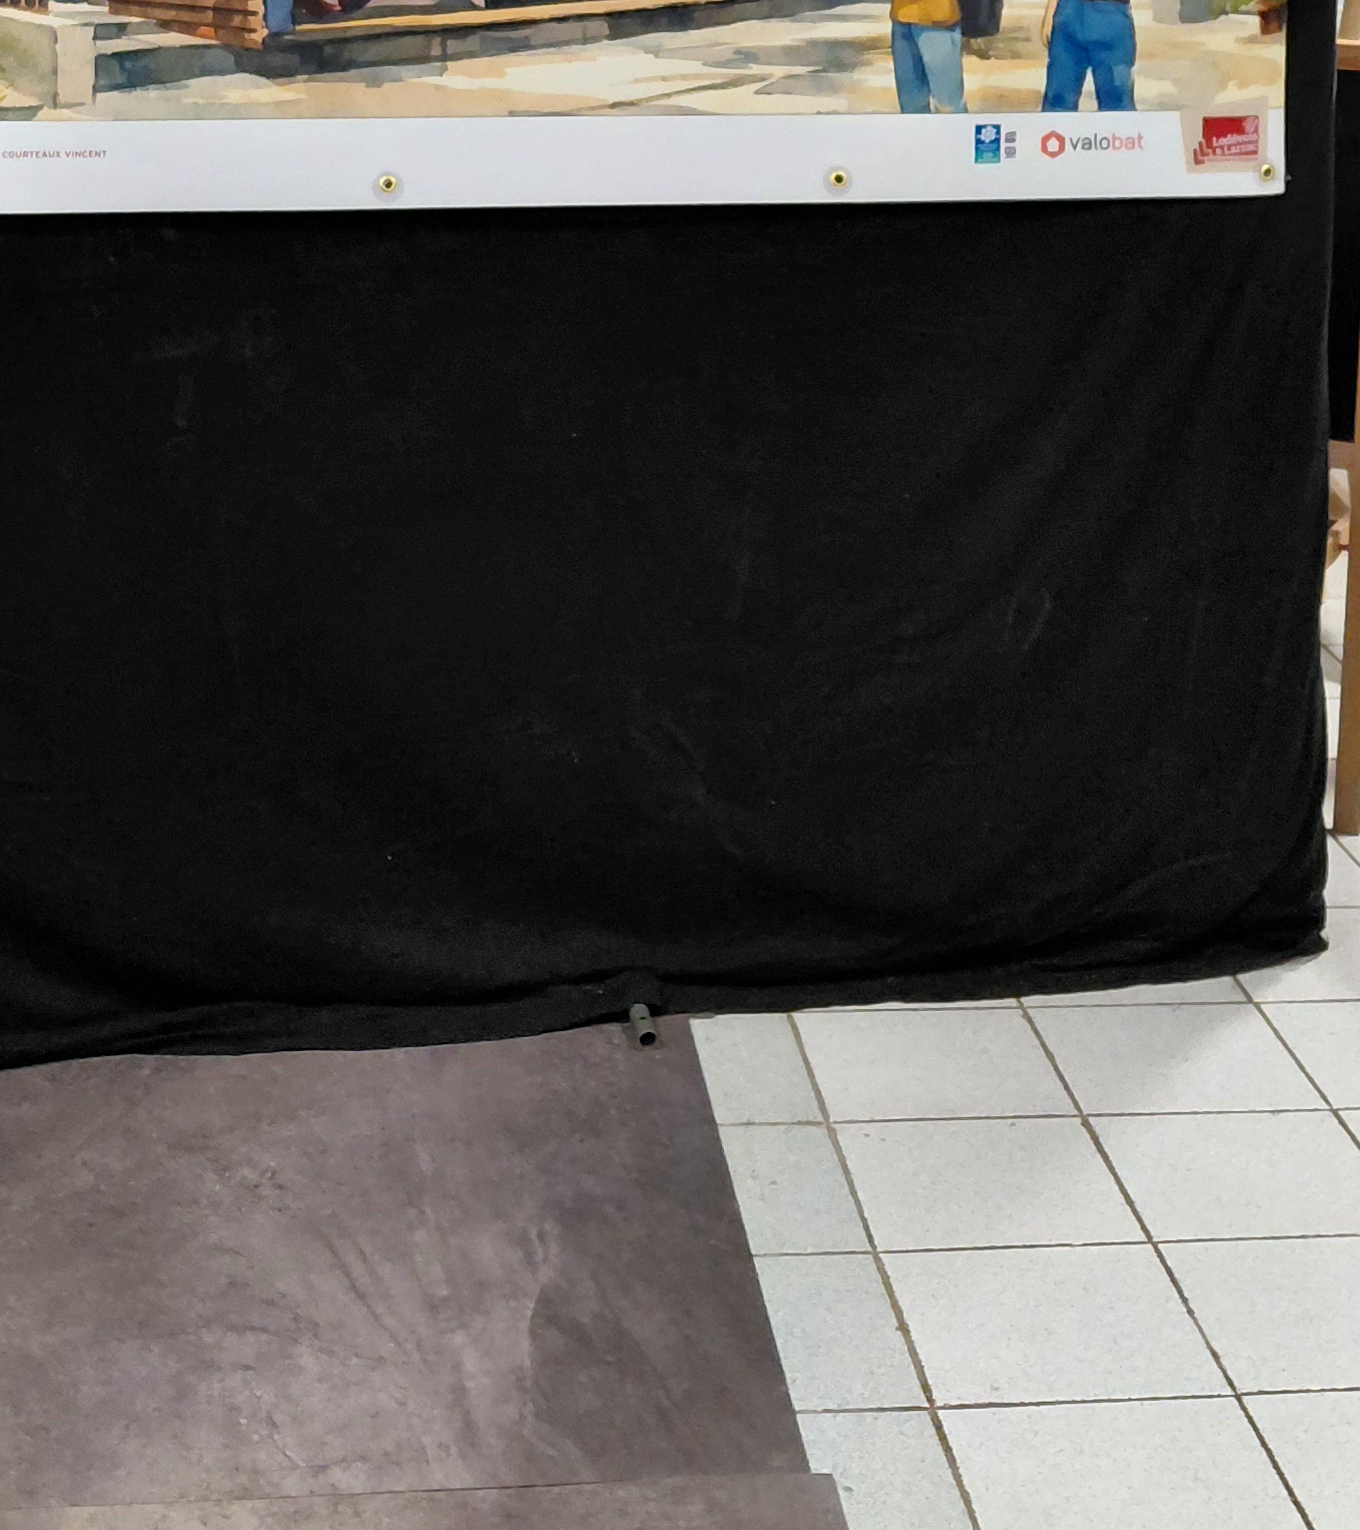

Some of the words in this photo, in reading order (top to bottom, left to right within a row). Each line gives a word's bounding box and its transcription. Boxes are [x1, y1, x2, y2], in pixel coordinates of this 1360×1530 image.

[1069, 132, 1144, 151] valobat
[1, 150, 62, 159] COURTEAUX
[64, 150, 107, 158] VINCENT
